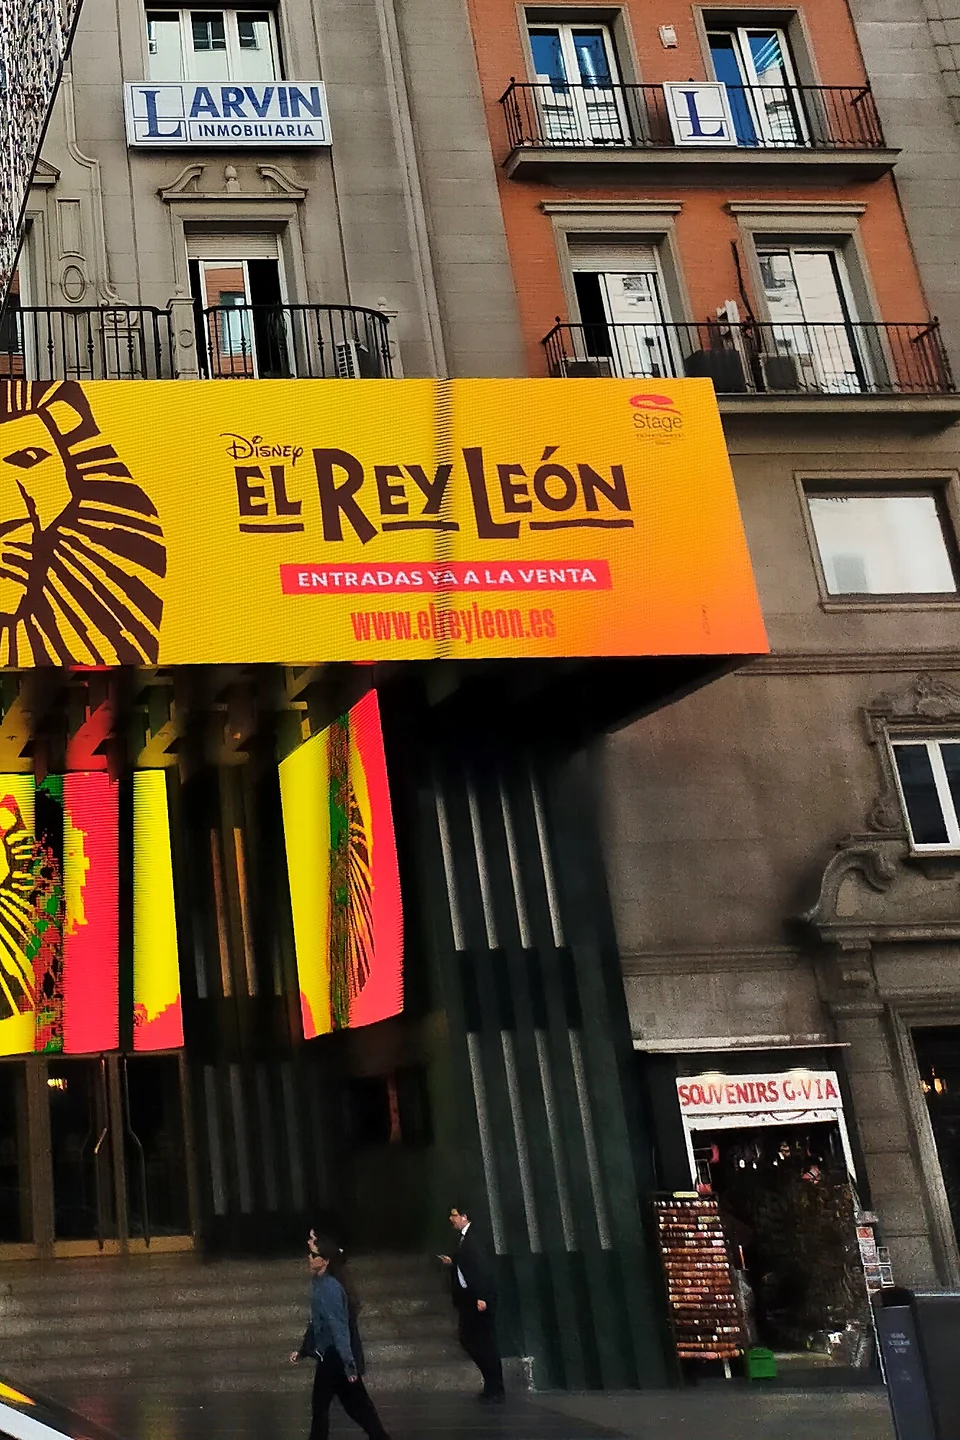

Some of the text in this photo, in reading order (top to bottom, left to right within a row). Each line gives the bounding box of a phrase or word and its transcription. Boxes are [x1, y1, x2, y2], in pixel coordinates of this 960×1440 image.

[679, 91, 724, 137] L
[198, 124, 314, 138] INMOBILIARIA
[633, 413, 682, 433] Stage
[234, 445, 632, 545] EL REY LEÓN
[298, 571, 423, 587] ENTRADAS
[462, 570, 480, 584] A
[485, 569, 514, 584] LA
[519, 567, 597, 583] VENTA
[678, 1080, 779, 1106] SOUVENIRS
